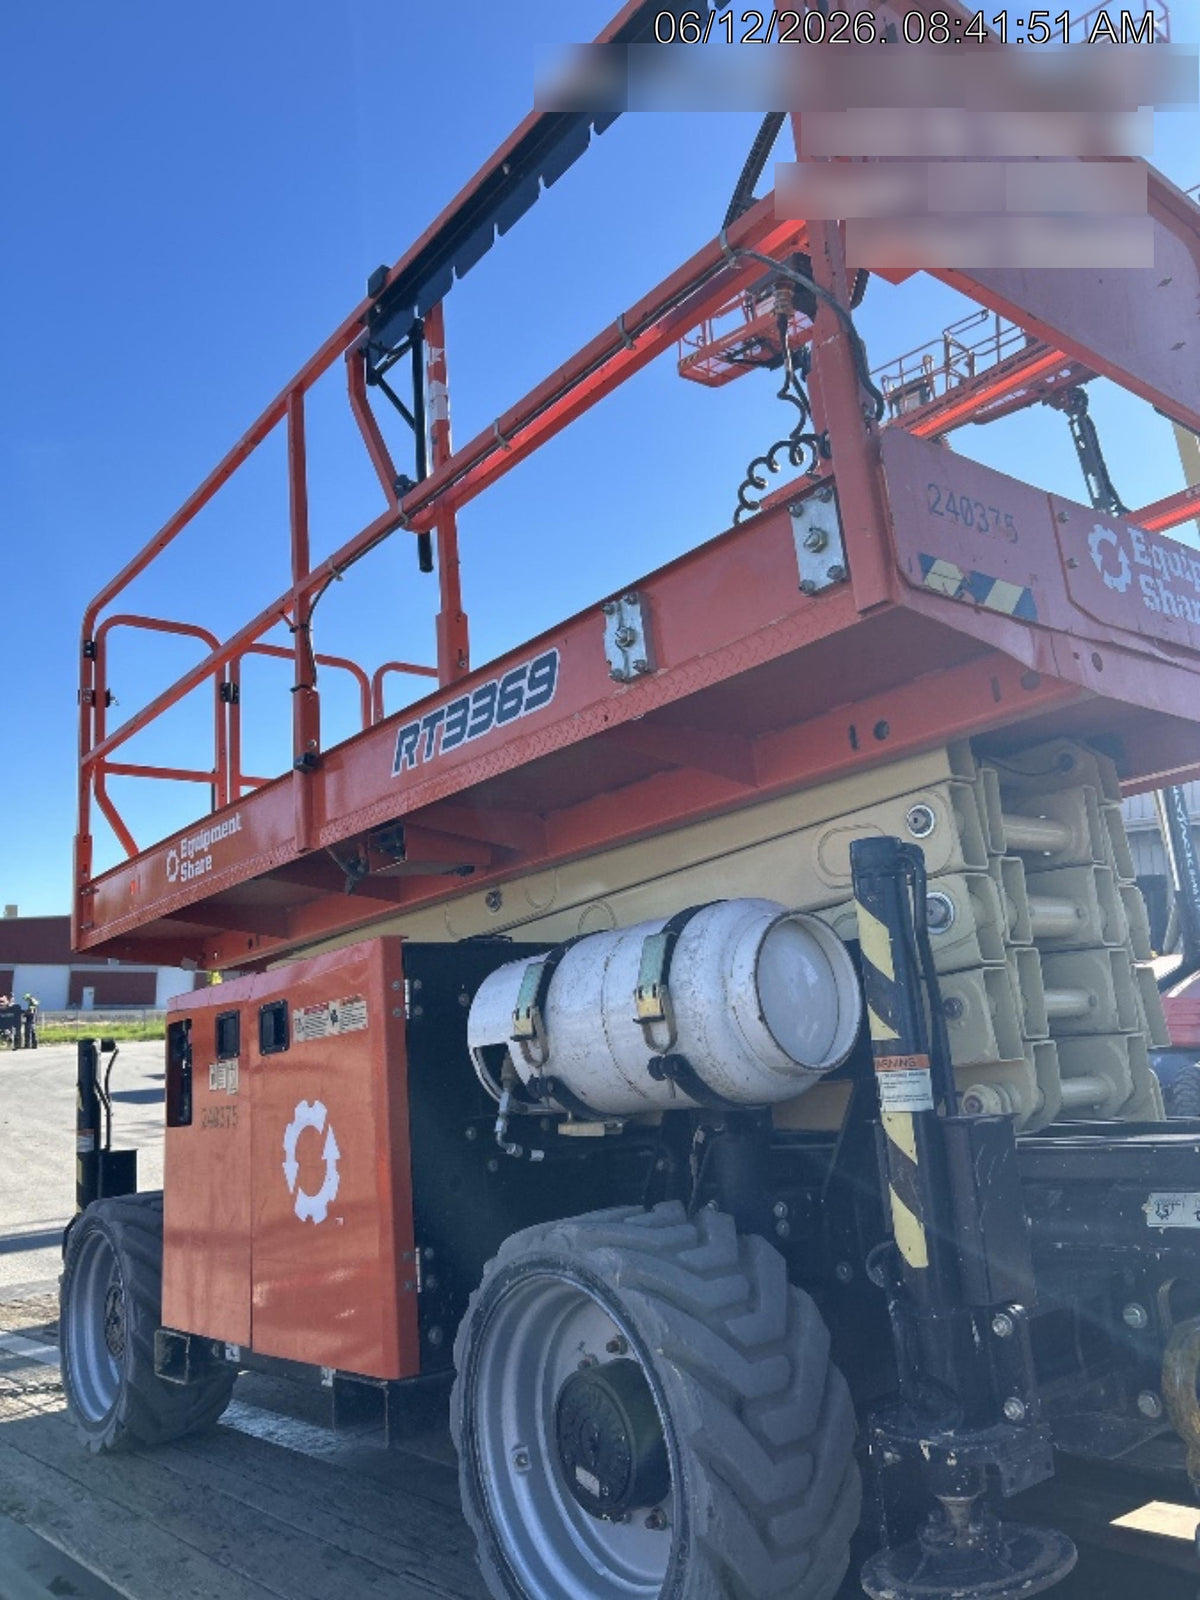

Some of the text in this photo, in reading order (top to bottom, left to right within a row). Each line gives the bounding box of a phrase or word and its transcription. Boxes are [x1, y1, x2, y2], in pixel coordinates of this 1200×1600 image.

[927, 483, 1018, 545] 240375
[391, 647, 560, 778] RT3369
[180, 812, 242, 858] Equipment
[180, 854, 213, 882] Share
